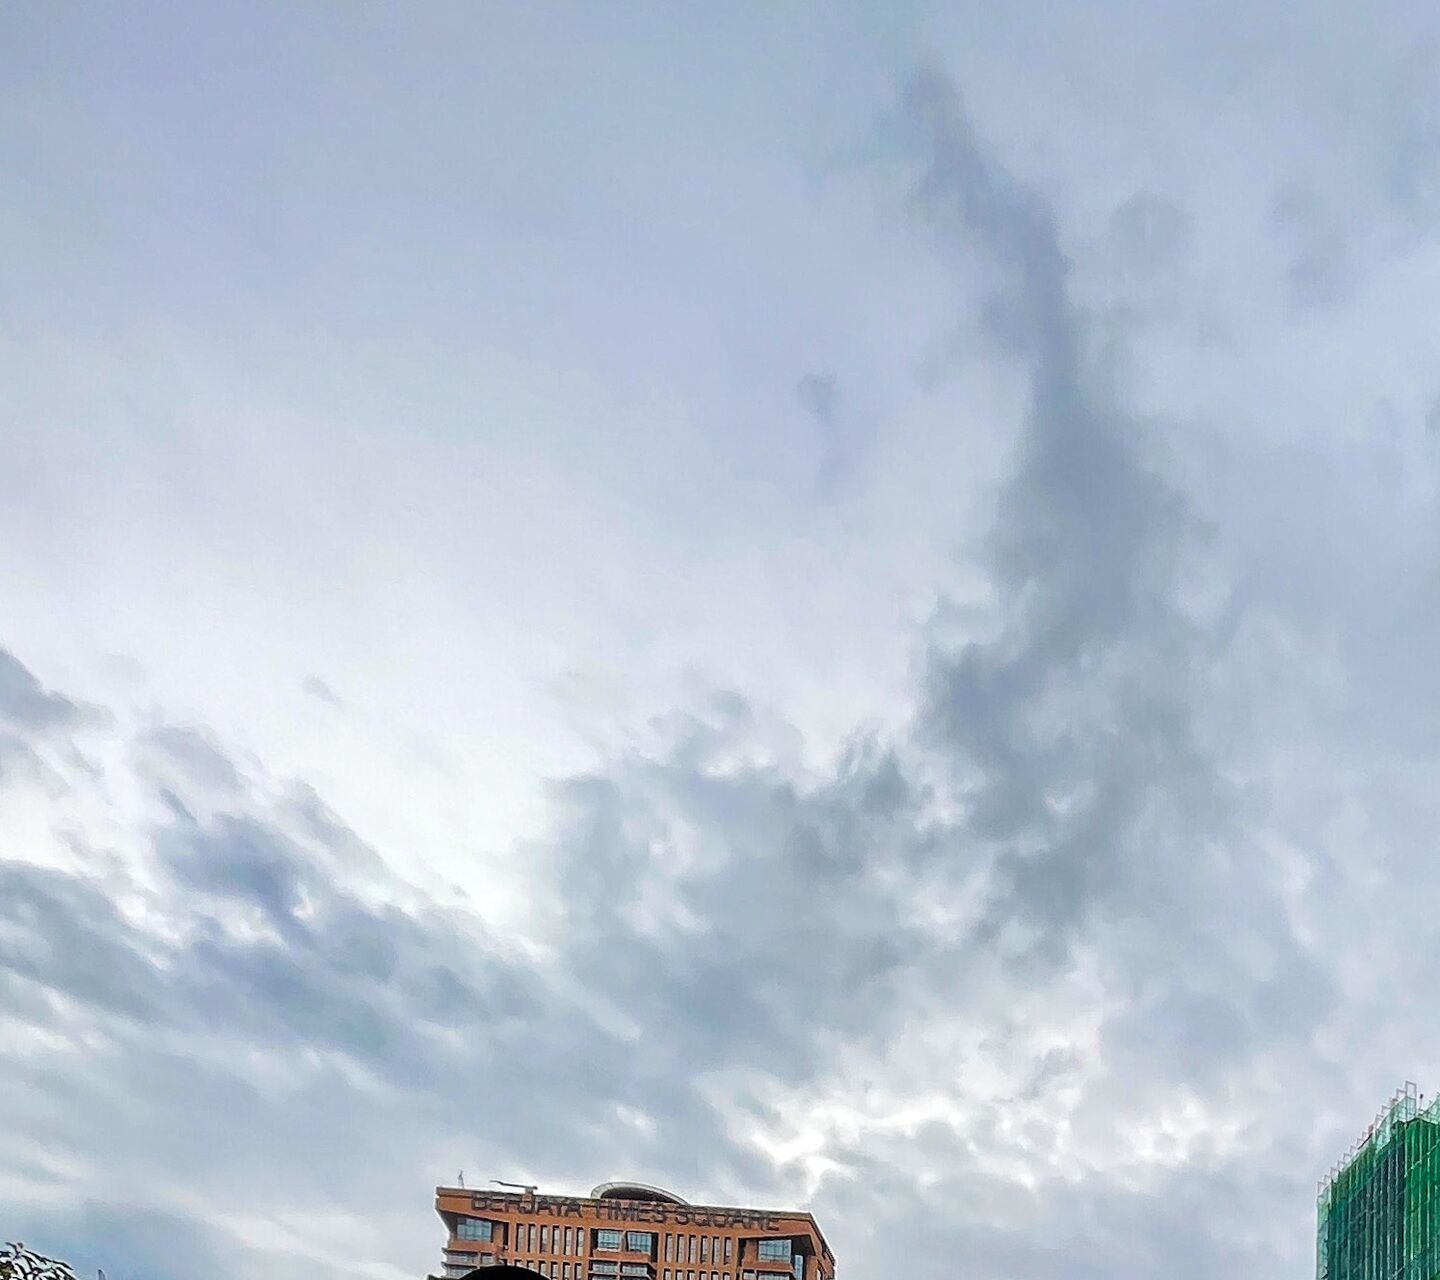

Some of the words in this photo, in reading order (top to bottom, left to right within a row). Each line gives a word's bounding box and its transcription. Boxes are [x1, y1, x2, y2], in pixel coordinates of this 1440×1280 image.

[471, 1193, 582, 1219] BERJAYA
[595, 1199, 668, 1223] TIMES
[674, 1204, 780, 1231] SQUARE
